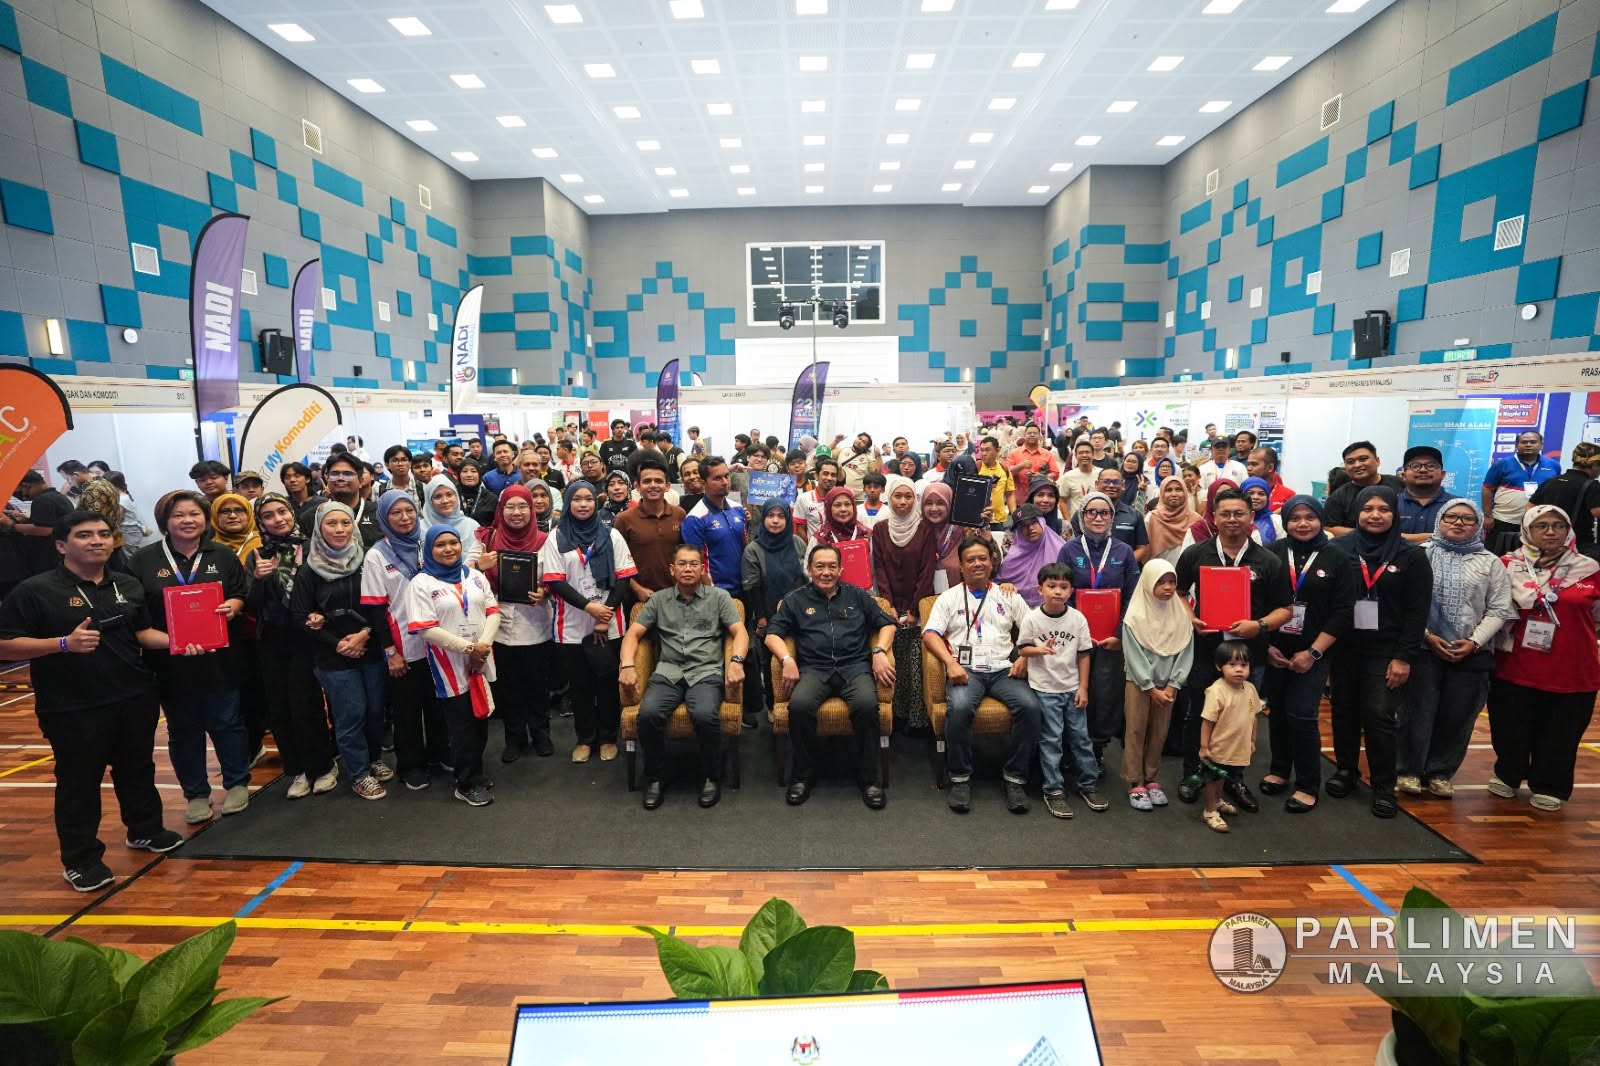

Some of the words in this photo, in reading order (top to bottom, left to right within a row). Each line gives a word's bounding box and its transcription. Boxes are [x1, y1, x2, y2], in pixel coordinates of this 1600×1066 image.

[205, 281, 234, 352] NADI
[299, 309, 314, 351] NADI
[456, 325, 469, 366] NADI
[80, 390, 92, 399] DAN
[93, 391, 119, 399] KOMODITI
[264, 401, 324, 472] MyKomoditi
[1049, 631, 1075, 642] SPORT
